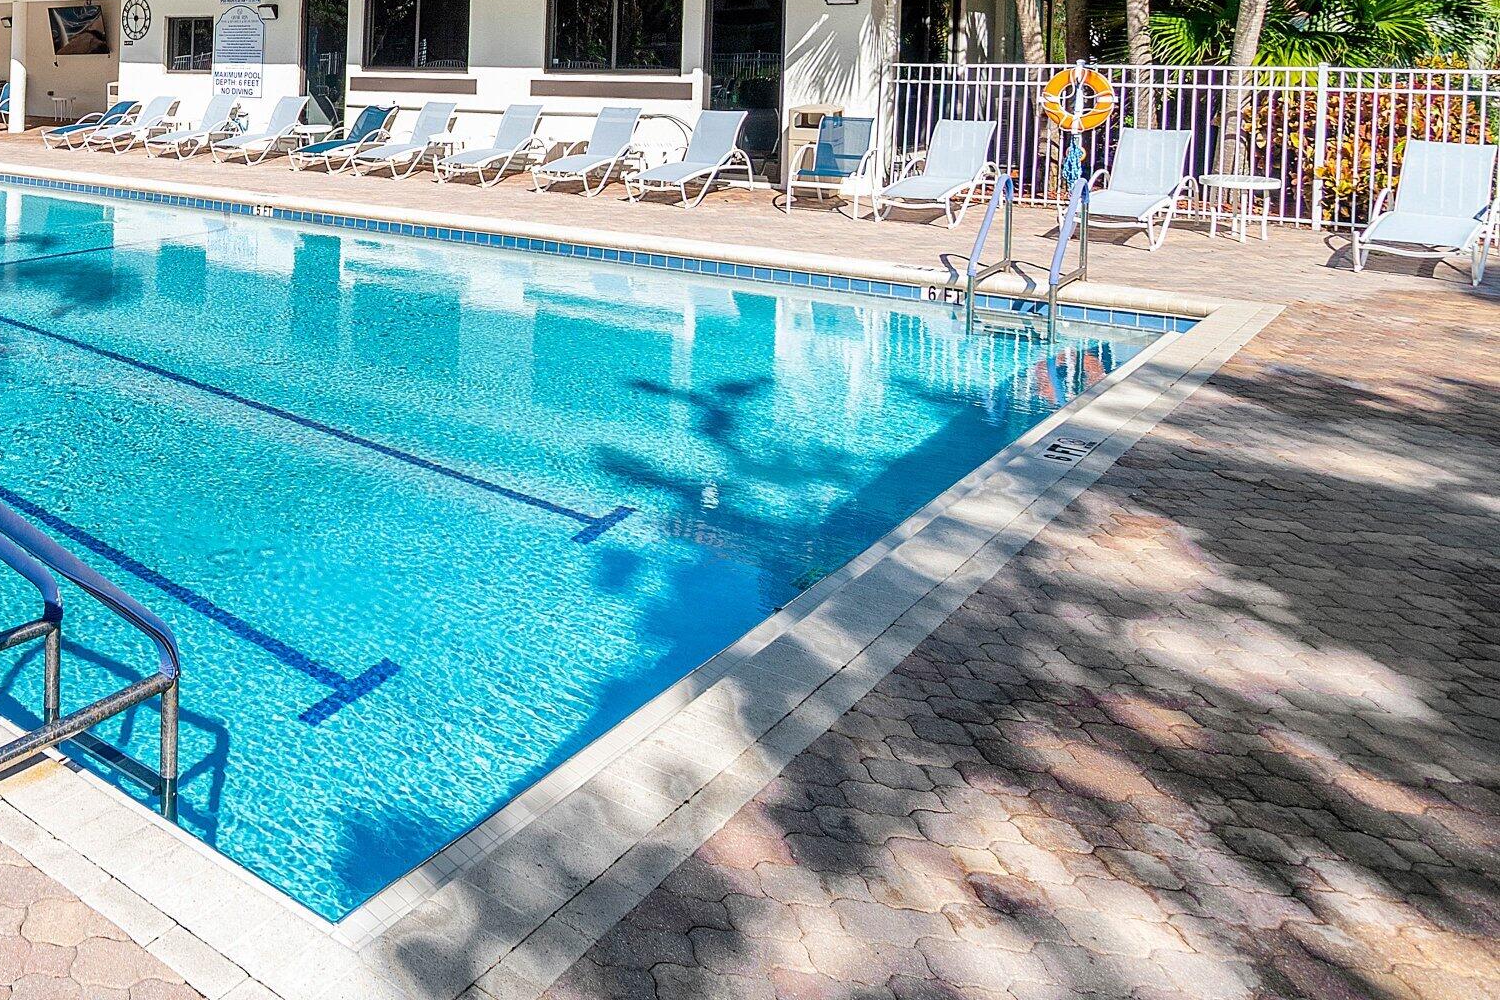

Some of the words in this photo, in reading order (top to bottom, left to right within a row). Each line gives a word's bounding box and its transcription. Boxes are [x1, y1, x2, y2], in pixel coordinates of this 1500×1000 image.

[243, 71, 261, 80] POOL
[243, 79, 260, 87] FEET
[220, 87, 230, 95] NO
[231, 87, 253, 95] DIVING
[256, 204, 261, 216] 5
[263, 205, 273, 217] FT
[928, 285, 936, 301] 6
[944, 287, 963, 304] FT
[1046, 443, 1087, 457] FT
[1043, 453, 1072, 462] 6
